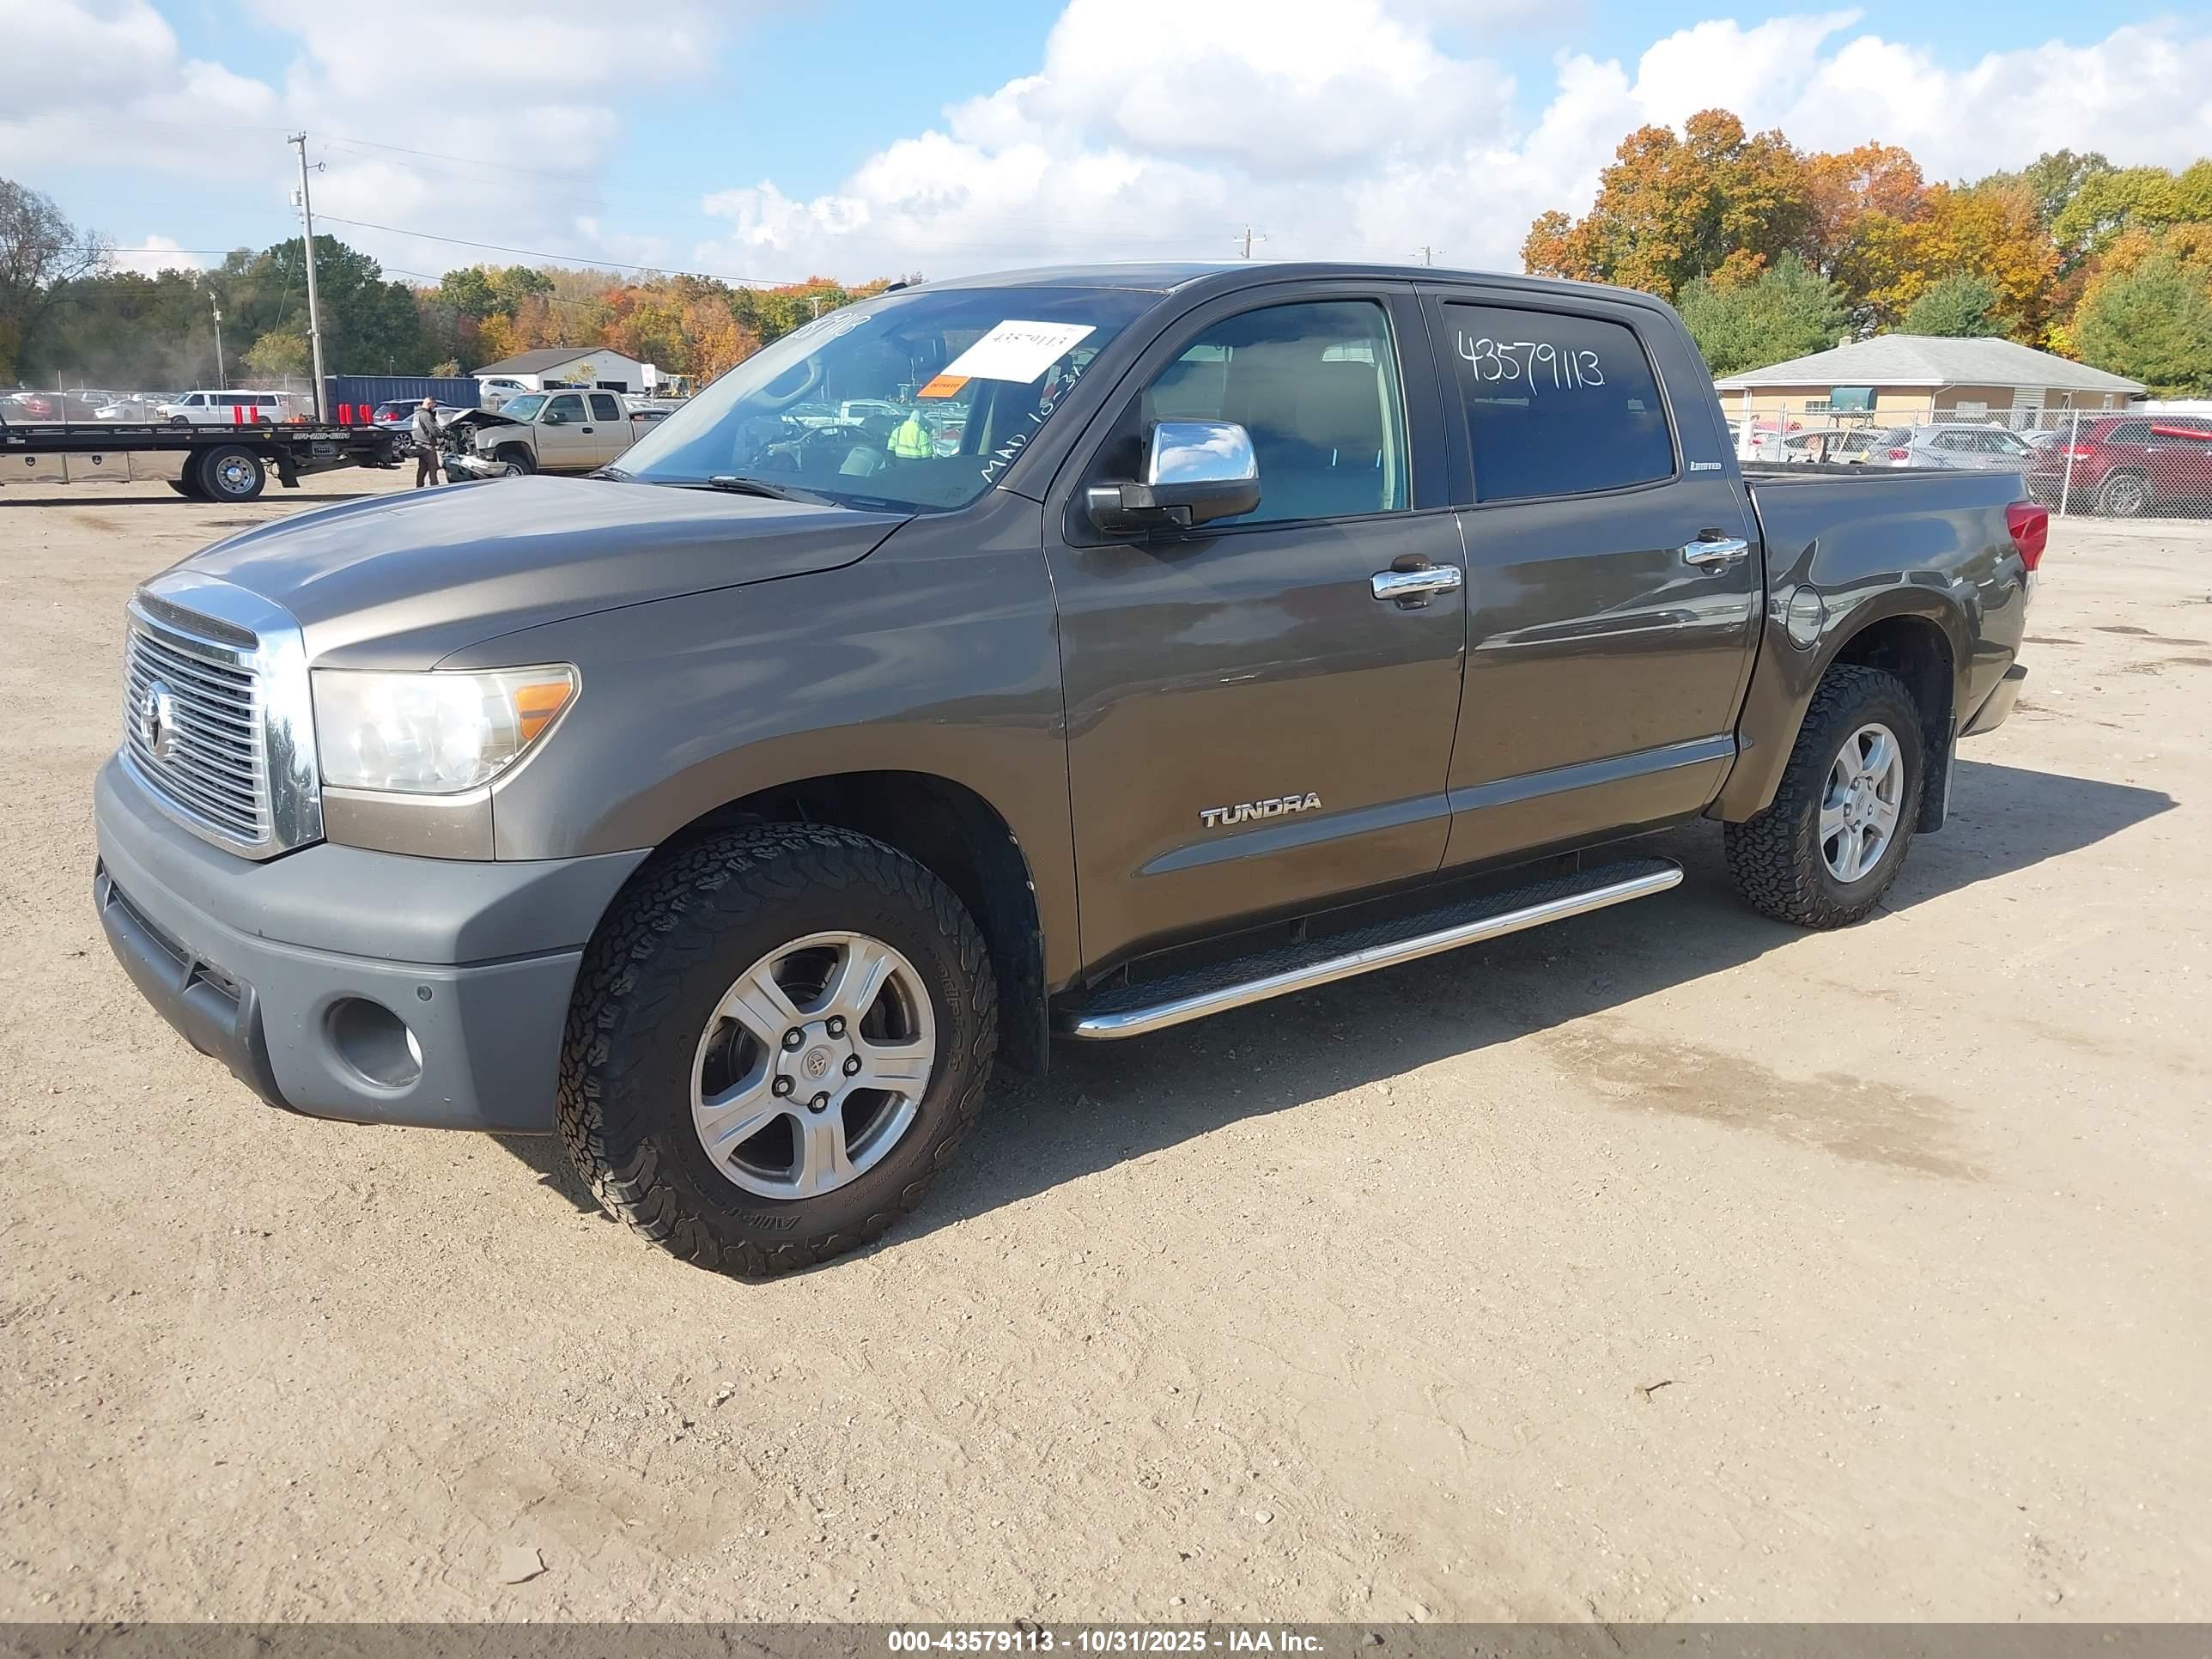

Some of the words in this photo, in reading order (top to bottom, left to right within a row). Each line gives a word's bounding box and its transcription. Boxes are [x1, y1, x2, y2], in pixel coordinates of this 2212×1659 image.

[1457, 330, 1607, 397] 43579113
[981, 433, 1028, 484] MAD
[1199, 791, 1323, 829] TUNDRA
